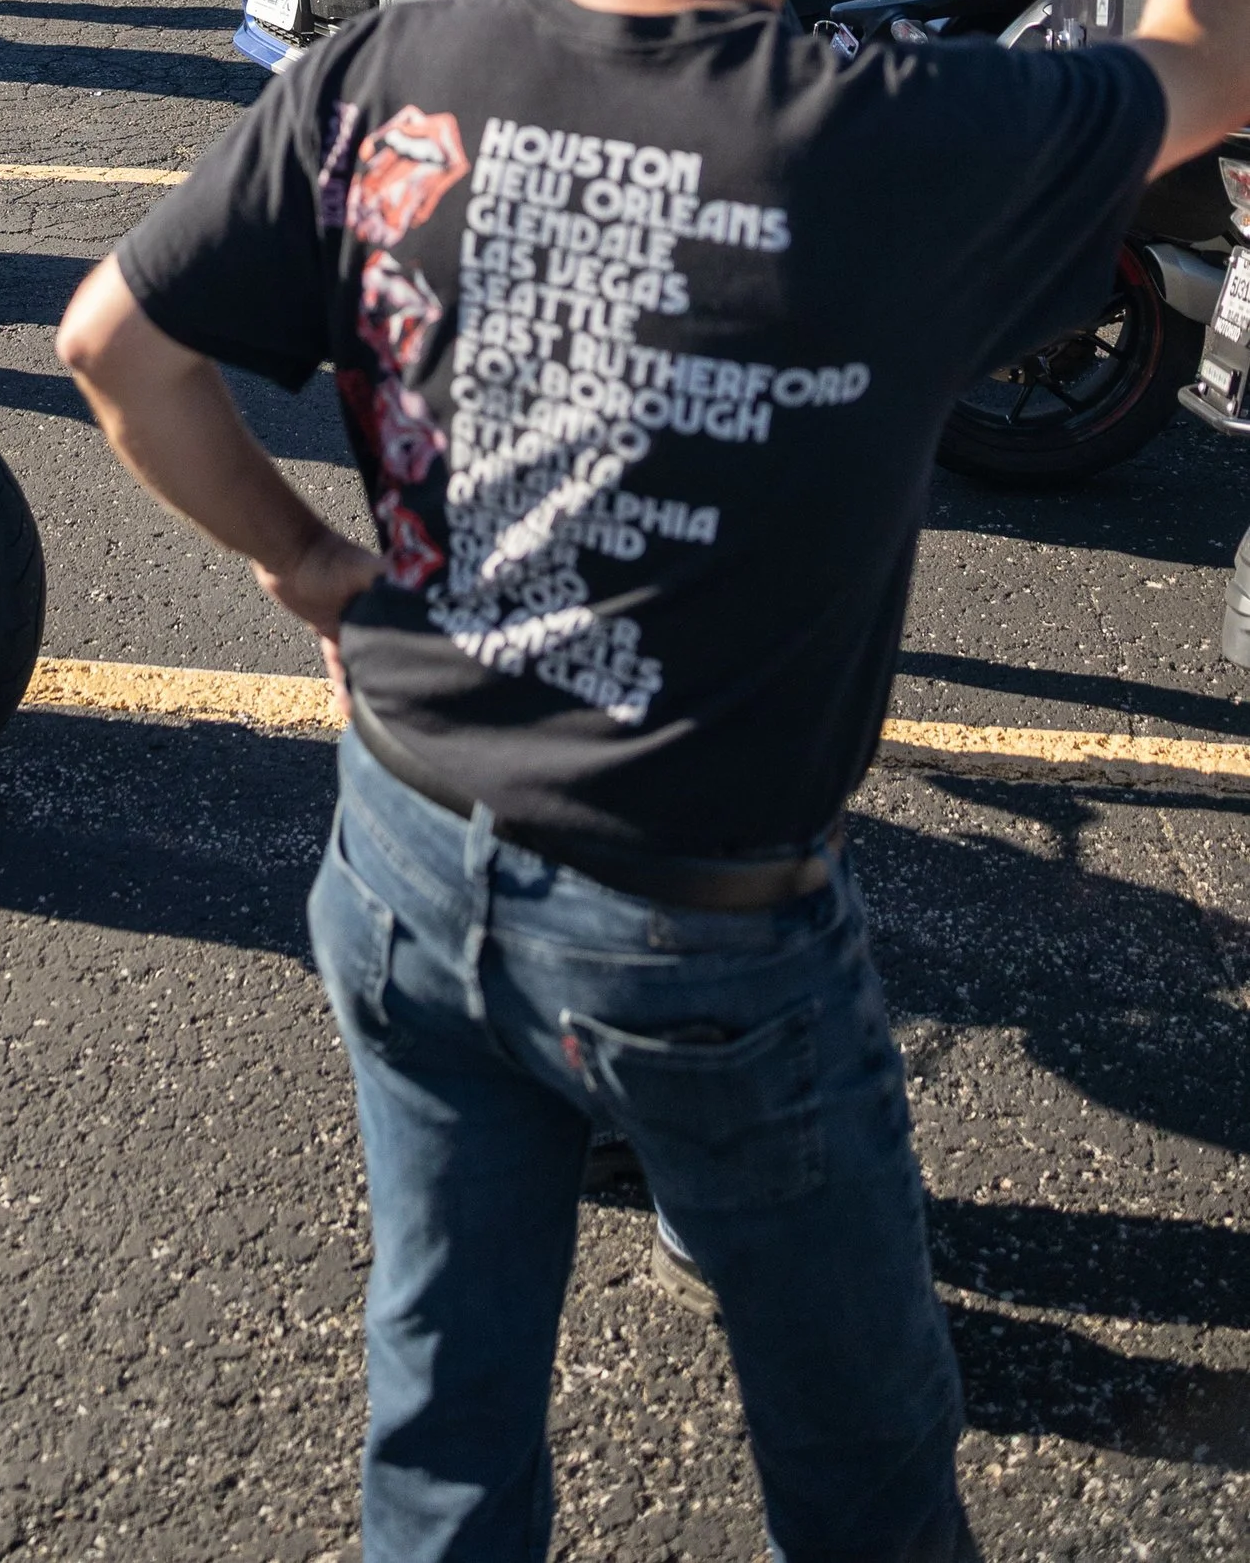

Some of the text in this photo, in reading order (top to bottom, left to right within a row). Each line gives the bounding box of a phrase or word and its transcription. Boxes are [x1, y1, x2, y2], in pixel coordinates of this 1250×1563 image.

[480, 116, 704, 194] HOUSTON
[466, 194, 678, 271] GLENDALE
[471, 154, 792, 253] NEW ORLEANS
[458, 270, 642, 344] SEATTLE
[460, 228, 691, 315] LAS VEGAS
[452, 336, 774, 443] FOXBOROUGH
[457, 301, 872, 409] EAST RUTHERFORD
[450, 374, 651, 464] ORLANDO
[535, 655, 652, 728] CLARA
